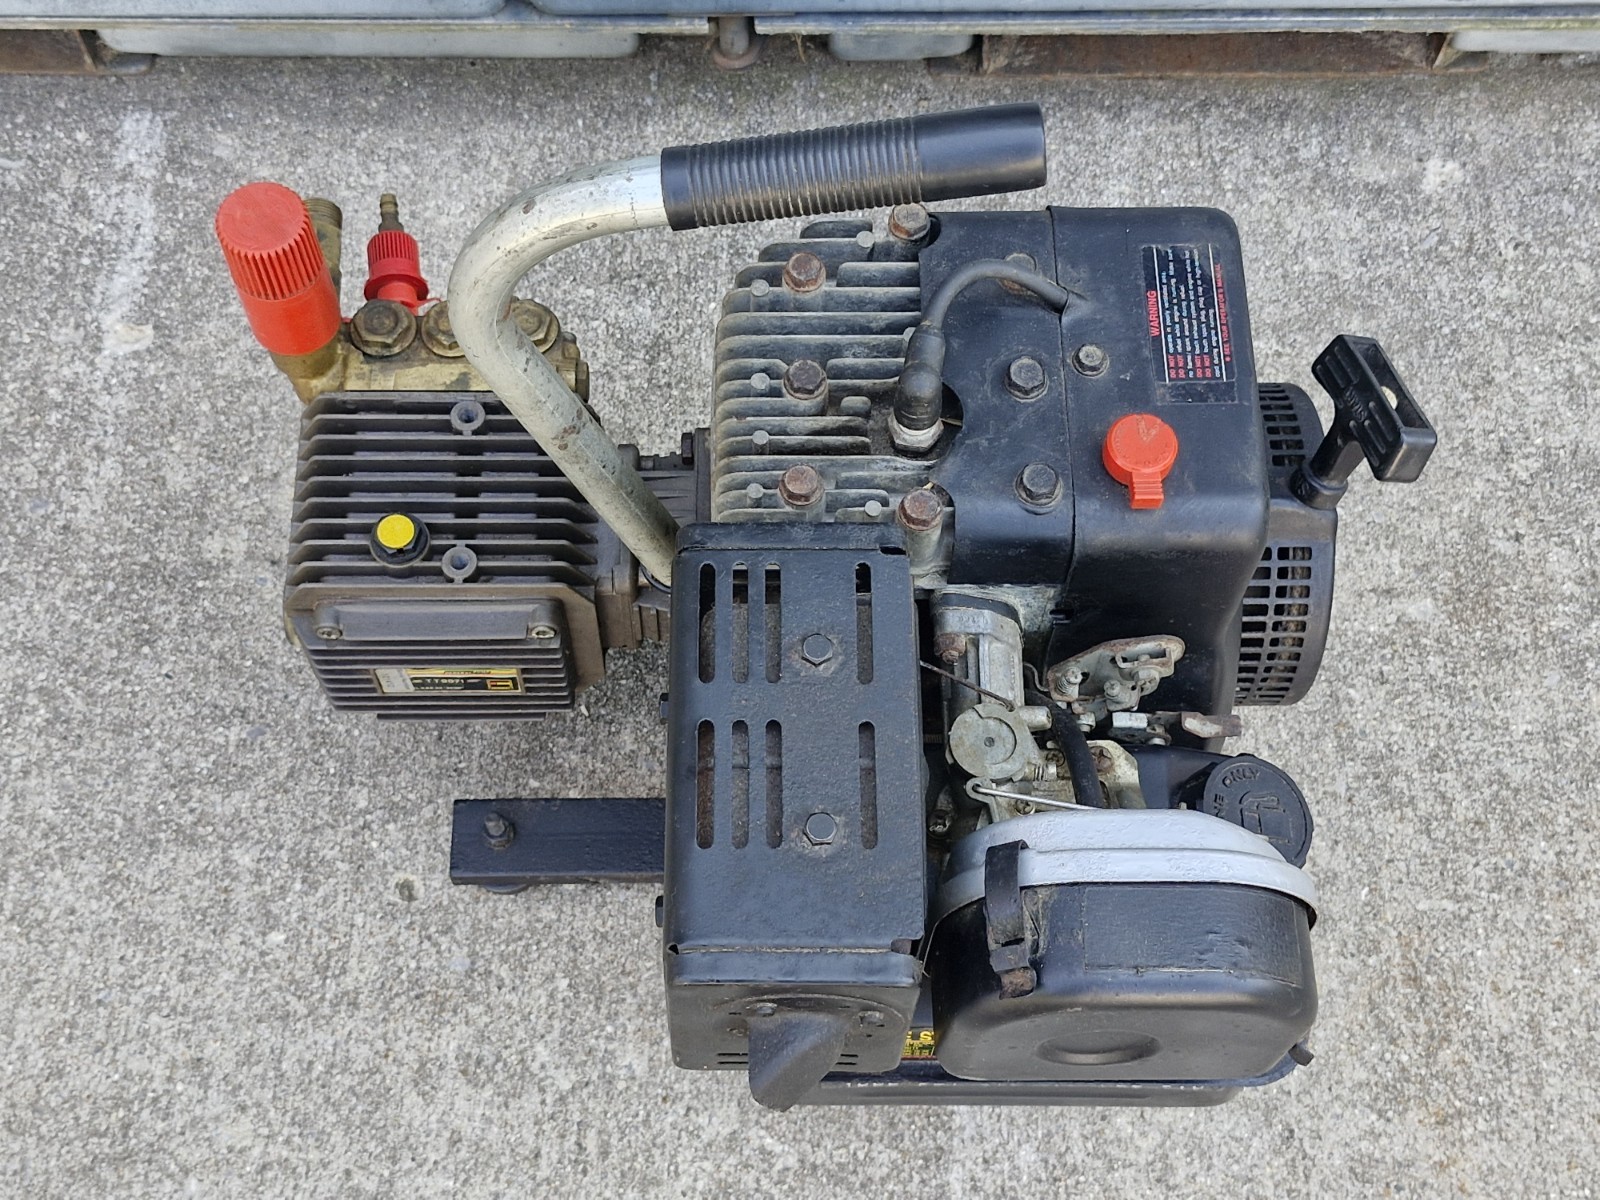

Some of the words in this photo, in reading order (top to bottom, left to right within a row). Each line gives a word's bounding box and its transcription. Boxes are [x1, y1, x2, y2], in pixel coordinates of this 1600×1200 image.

[1215, 263, 1223, 287] MANUAL
[1147, 290, 1160, 336] WARNING
[1222, 767, 1260, 788] ONLY
